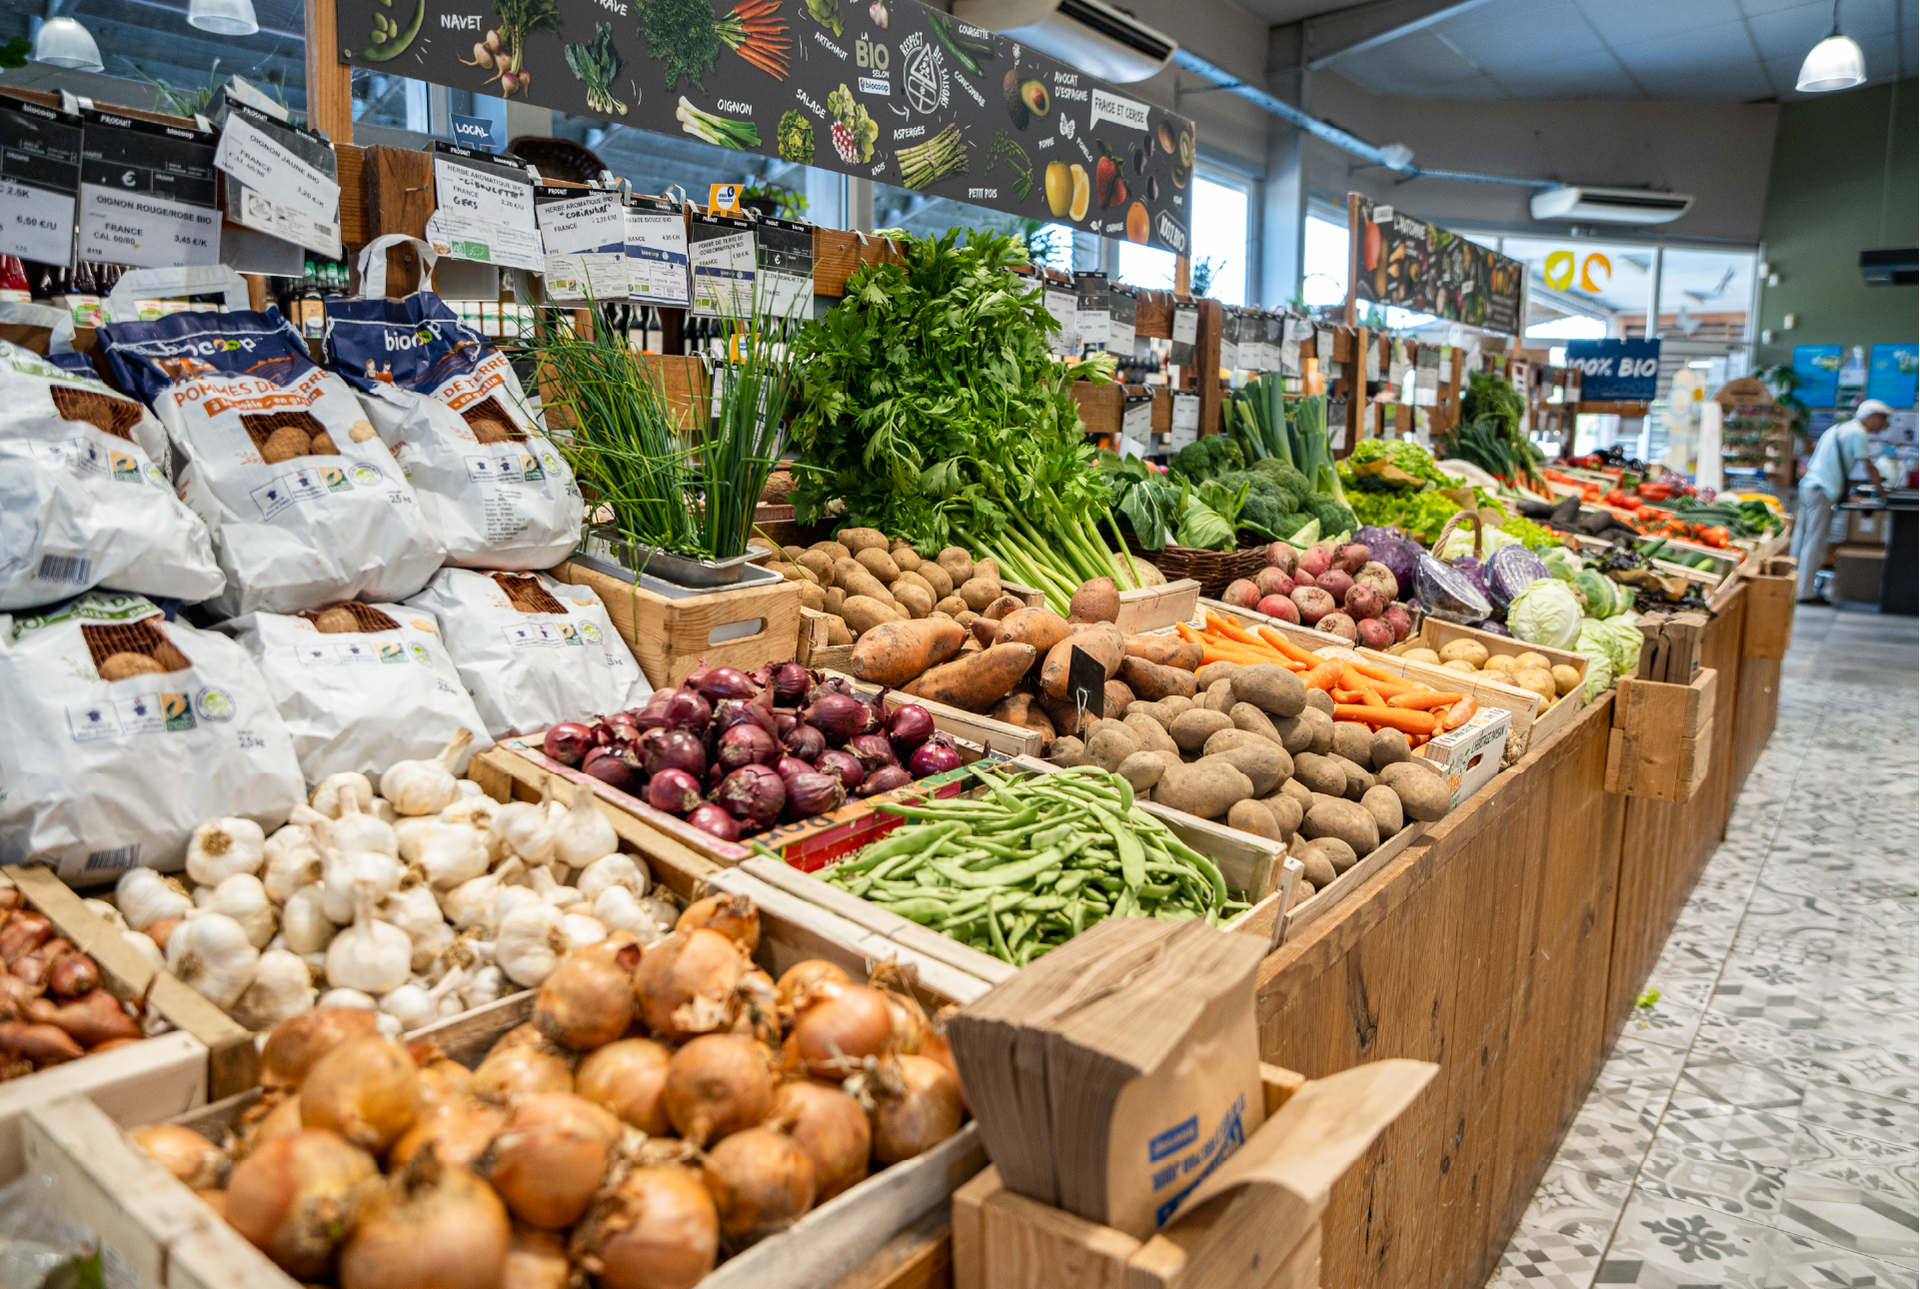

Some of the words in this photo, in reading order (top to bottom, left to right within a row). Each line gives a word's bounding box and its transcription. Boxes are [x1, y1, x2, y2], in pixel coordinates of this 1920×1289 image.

[441, 14, 482, 31] NAVET
[861, 32, 869, 41] LA
[958, 24, 990, 40] COURGETTE
[814, 31, 848, 61] ARTICHAUT
[899, 31, 923, 57] RESPECT
[855, 40, 890, 70] BIO
[932, 45, 944, 65] DES
[872, 69, 890, 79] SELON
[1054, 71, 1079, 87] AVOCAT
[865, 80, 889, 92] biocoop
[941, 68, 950, 109] SAISONS
[953, 71, 986, 108] CONCOMBRE
[1054, 86, 1089, 102] D'ESPAGNE
[23, 102, 57, 120] biocoop
[717, 99, 753, 116] OIGNON
[795, 88, 827, 119] SALADE
[1094, 97, 1115, 115] FRAISE
[1116, 104, 1125, 117] ET
[1125, 107, 1145, 123] CERISE
[100, 114, 132, 128] PRODUIT
[243, 107, 269, 122] PRODUIT
[165, 127, 194, 140] biocoop
[296, 128, 318, 144] biocoop
[456, 123, 489, 138] LOCAL
[893, 125, 925, 141] ASPERGES
[1038, 137, 1055, 150] POMME
[228, 151, 245, 166] CAL
[240, 149, 272, 174] FRANCE
[250, 134, 281, 158] OIGNON
[281, 156, 306, 176] JAUNE
[307, 173, 320, 185] BIO
[871, 161, 886, 176] RADIS
[122, 170, 136, 187] €
[447, 165, 470, 177] HERBE
[470, 171, 512, 189] AROMATIQUE
[513, 184, 524, 193] BIO
[453, 186, 480, 199] FRANCE
[548, 188, 567, 196] PRODUIT
[968, 188, 984, 199] PETIT
[985, 188, 998, 199] POIS
[97, 195, 134, 210] OIGNON
[136, 202, 195, 222] ROUGE/ROSE
[196, 215, 212, 225] BIO
[453, 196, 479, 210] GERS
[545, 205, 565, 214] HERBE
[566, 199, 602, 210] AROMATIQUE
[603, 195, 613, 203] BIO
[40, 220, 57, 231] €/U
[105, 222, 144, 237] FRANCE
[554, 223, 579, 233] FRANCE
[93, 231, 111, 241] CAL
[174, 235, 191, 245] 3,45
[192, 237, 208, 247] €/K
[1567, 357, 1614, 377] 100%
[1617, 357, 1657, 378] BIO
[442, 380, 465, 398] DE
[464, 355, 509, 389] TERRE
[173, 382, 253, 408] POMMES
[254, 379, 282, 394] DE
[289, 369, 332, 394] ERRE
